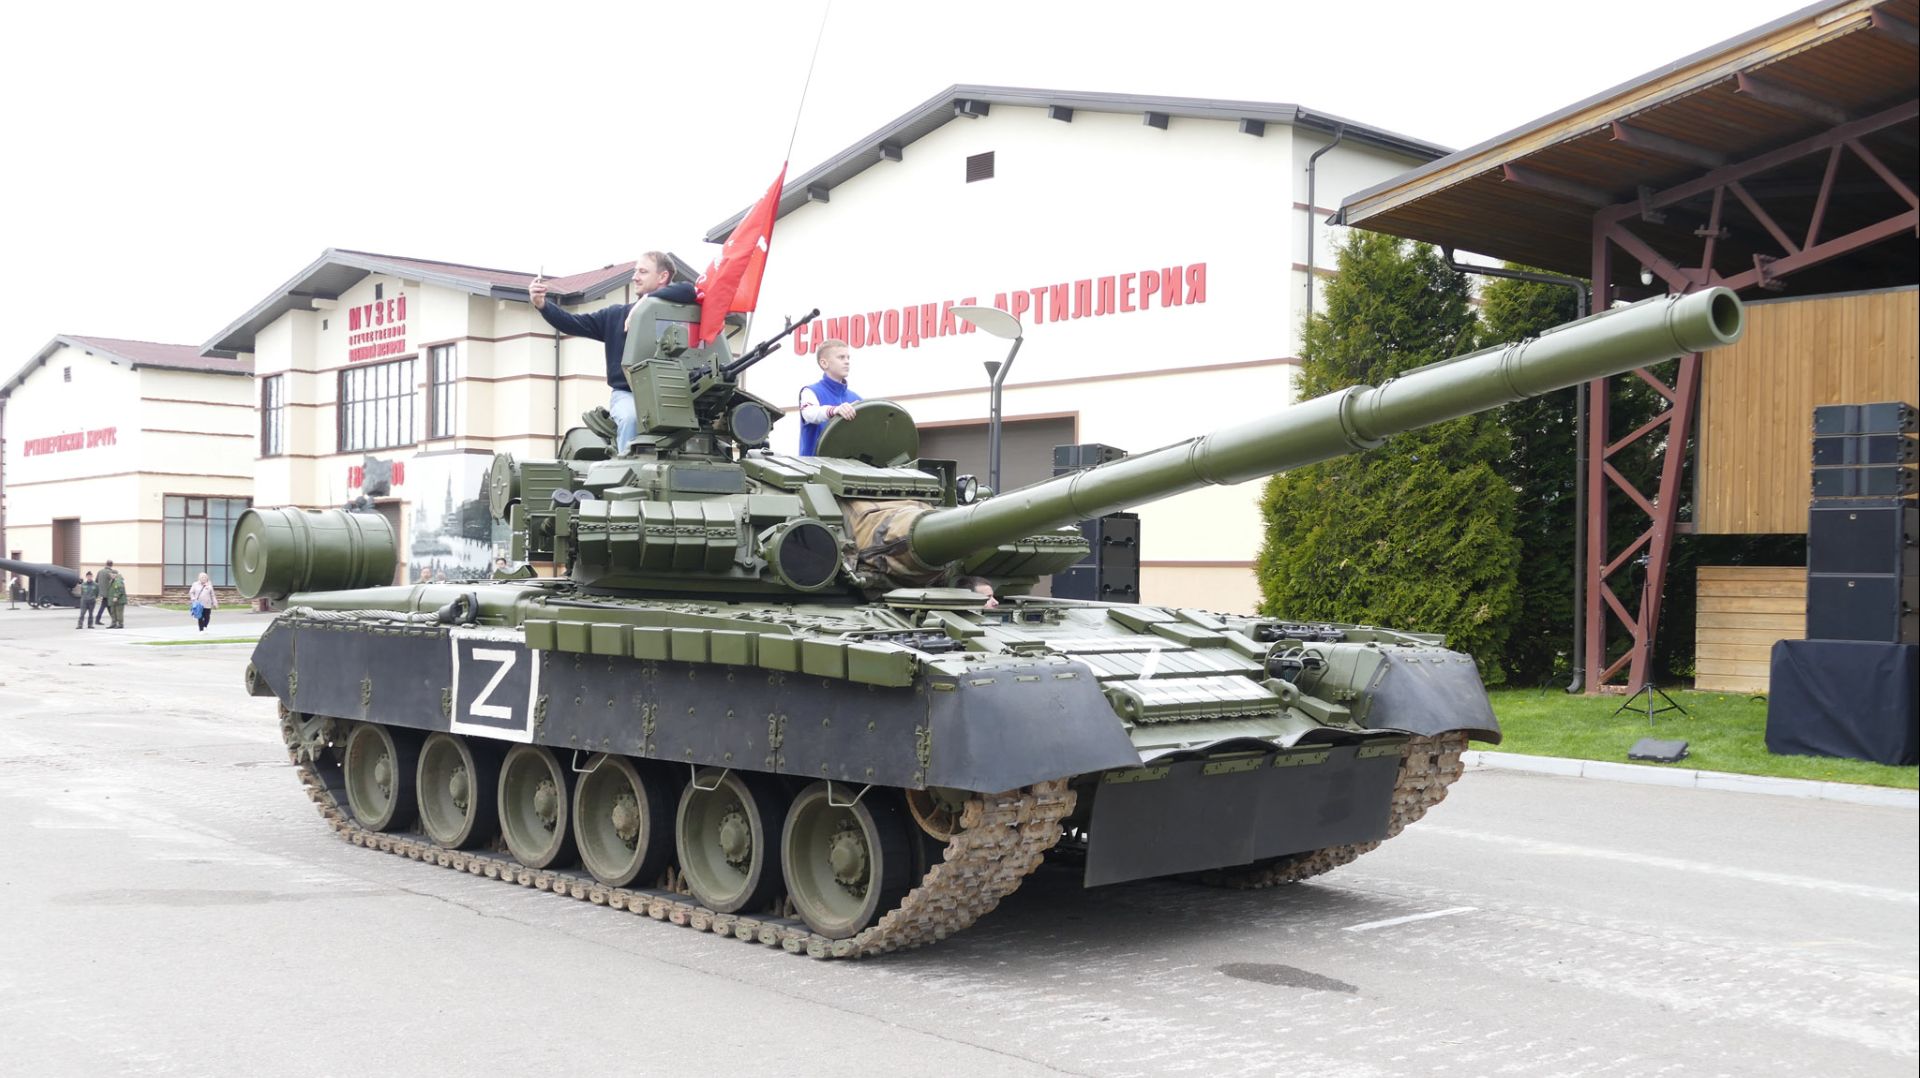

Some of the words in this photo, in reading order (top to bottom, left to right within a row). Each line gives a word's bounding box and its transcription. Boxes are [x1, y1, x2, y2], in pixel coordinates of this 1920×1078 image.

[349, 292, 406, 331] МУЗЕЙ
[349, 323, 406, 346] ОТЕЧЕСТВЕННОЙ
[470, 648, 516, 720] Z
